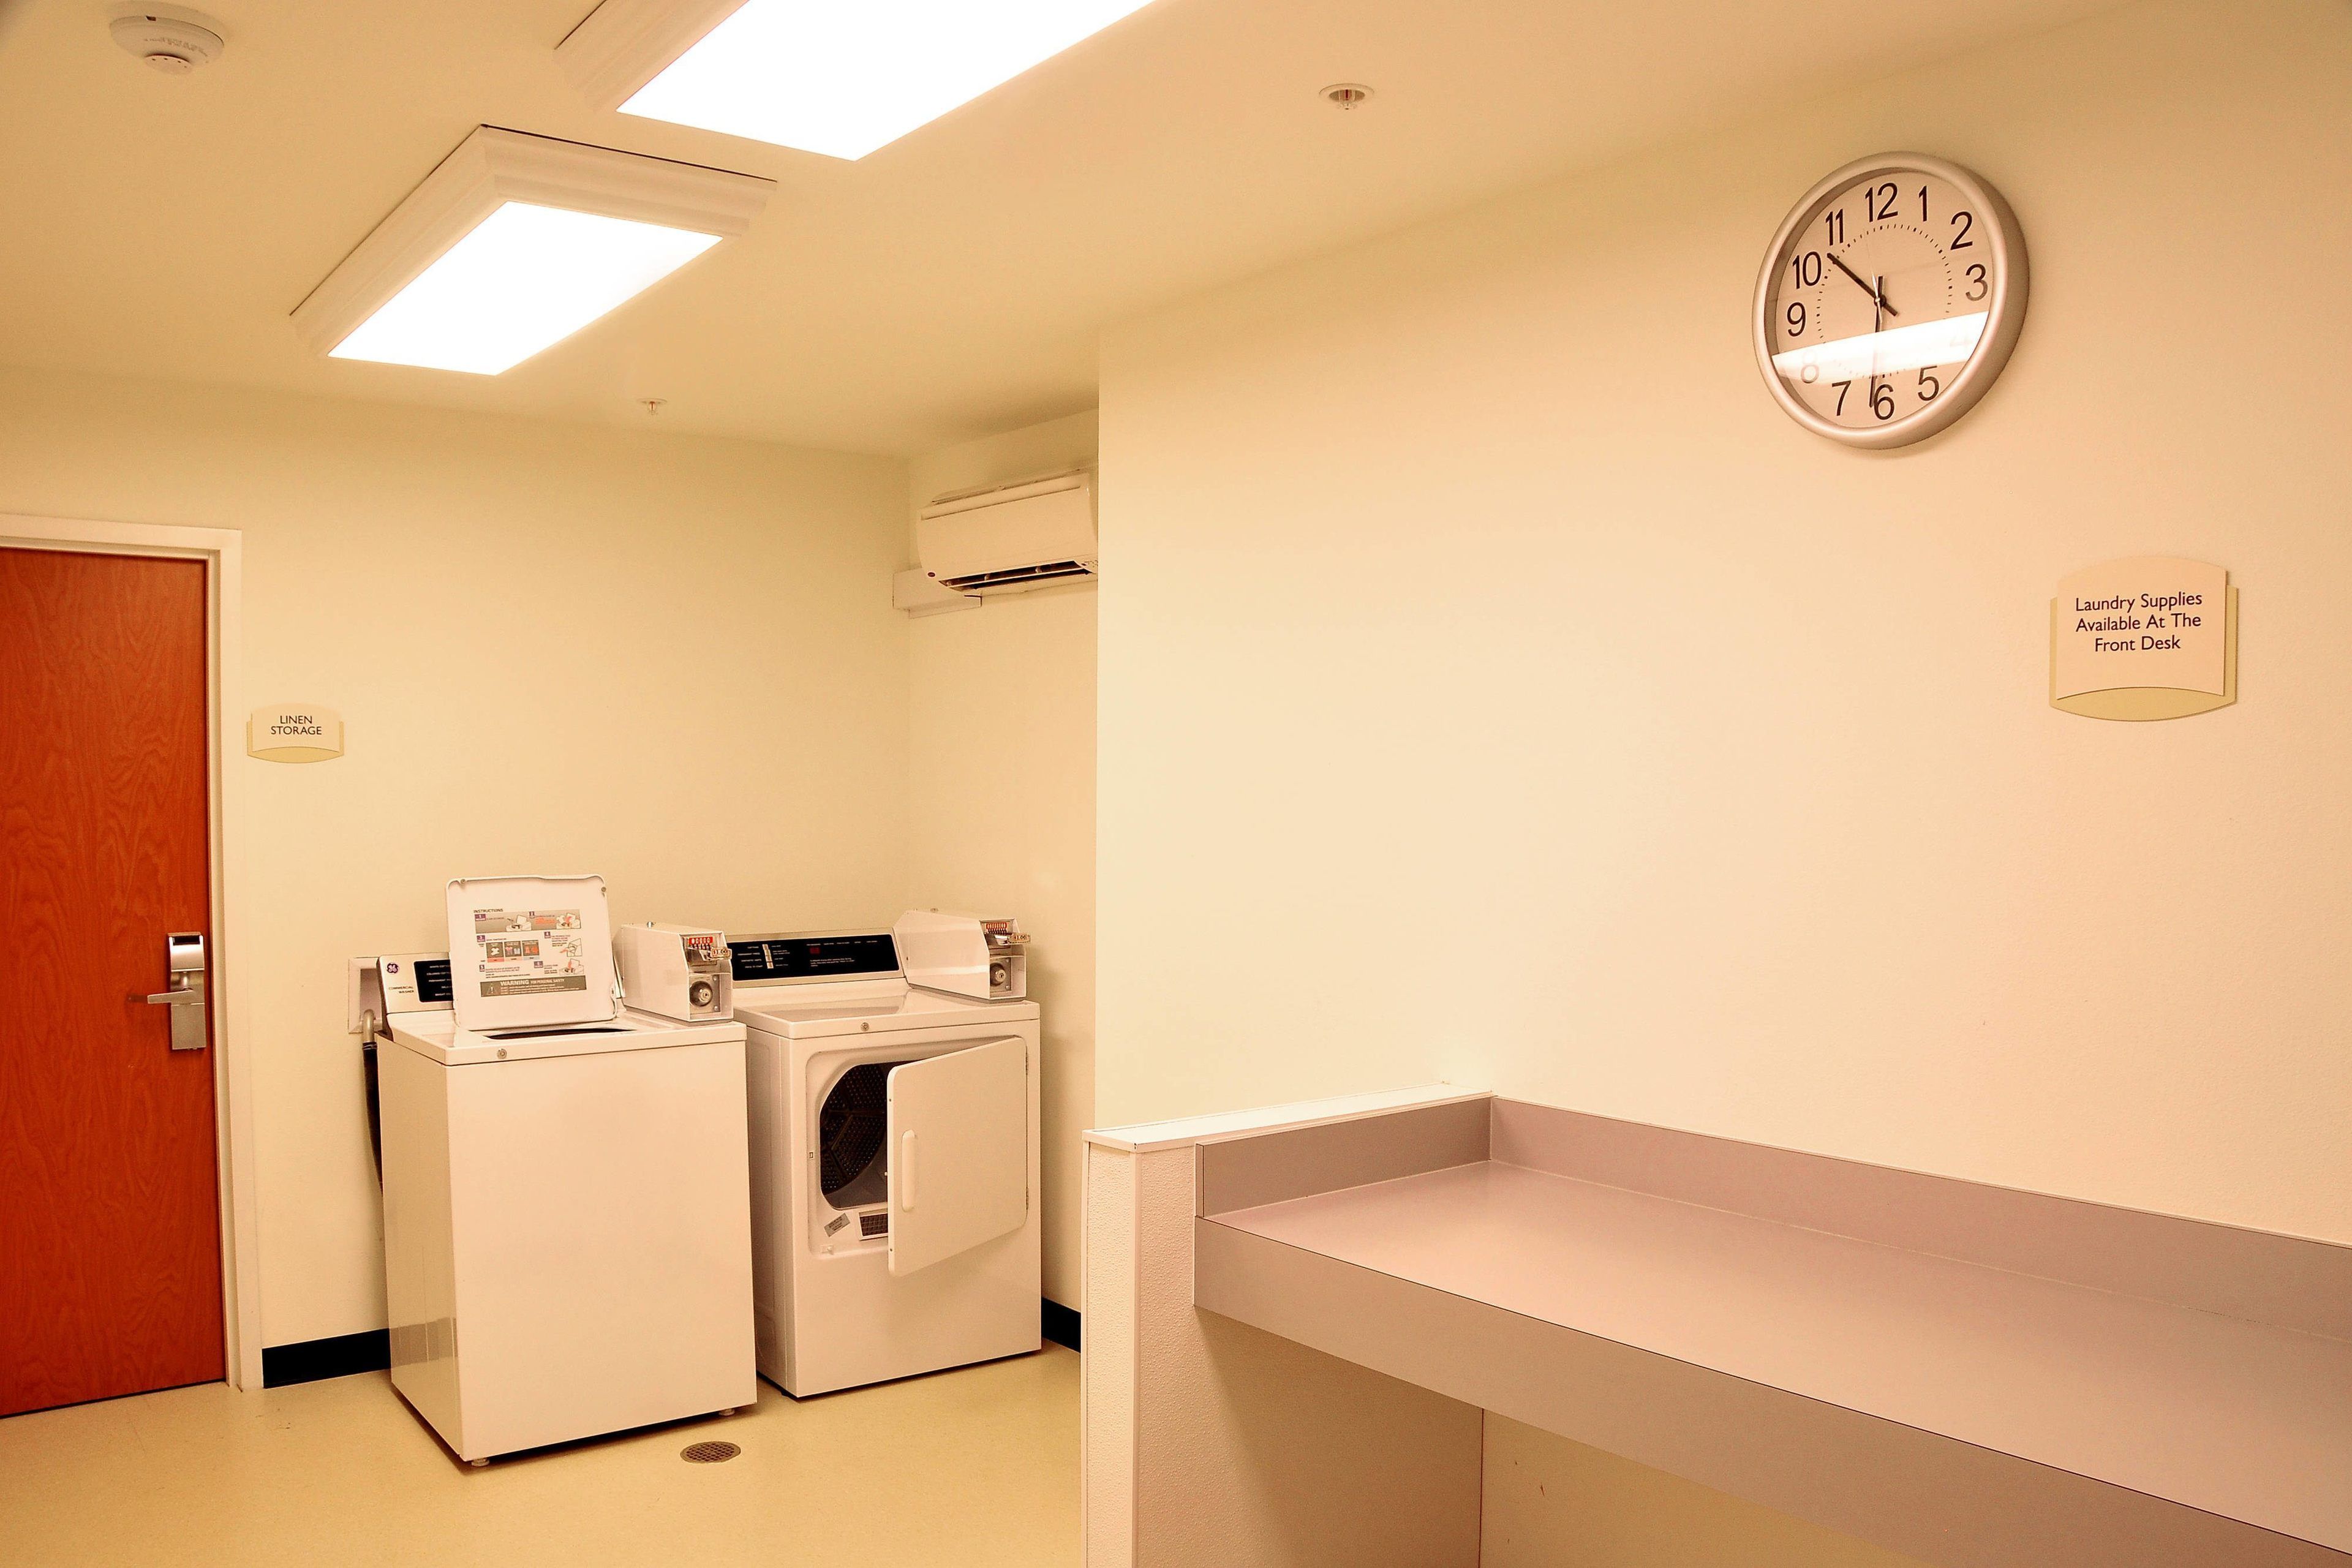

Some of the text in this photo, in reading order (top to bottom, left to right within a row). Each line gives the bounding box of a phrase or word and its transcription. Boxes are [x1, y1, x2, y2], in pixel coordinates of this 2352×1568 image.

[1864, 182, 1898, 222] 12
[1918, 186, 1928, 222] 1
[1825, 208, 1845, 246] 11
[1950, 211, 1973, 251] 2
[1792, 251, 1822, 289] 10
[1965, 263, 1989, 301] 3
[1787, 301, 1806, 337] 9
[1831, 380, 1852, 417] 7
[1917, 365, 1940, 401] 5
[1874, 384, 1895, 420] 6
[2076, 591, 2203, 614] Laundry Supplies
[2075, 612, 2201, 632] Available At The
[2095, 635, 2181, 652] Front Desk
[271, 726, 322, 735] STORAGE
[280, 715, 312, 724] LINEN
